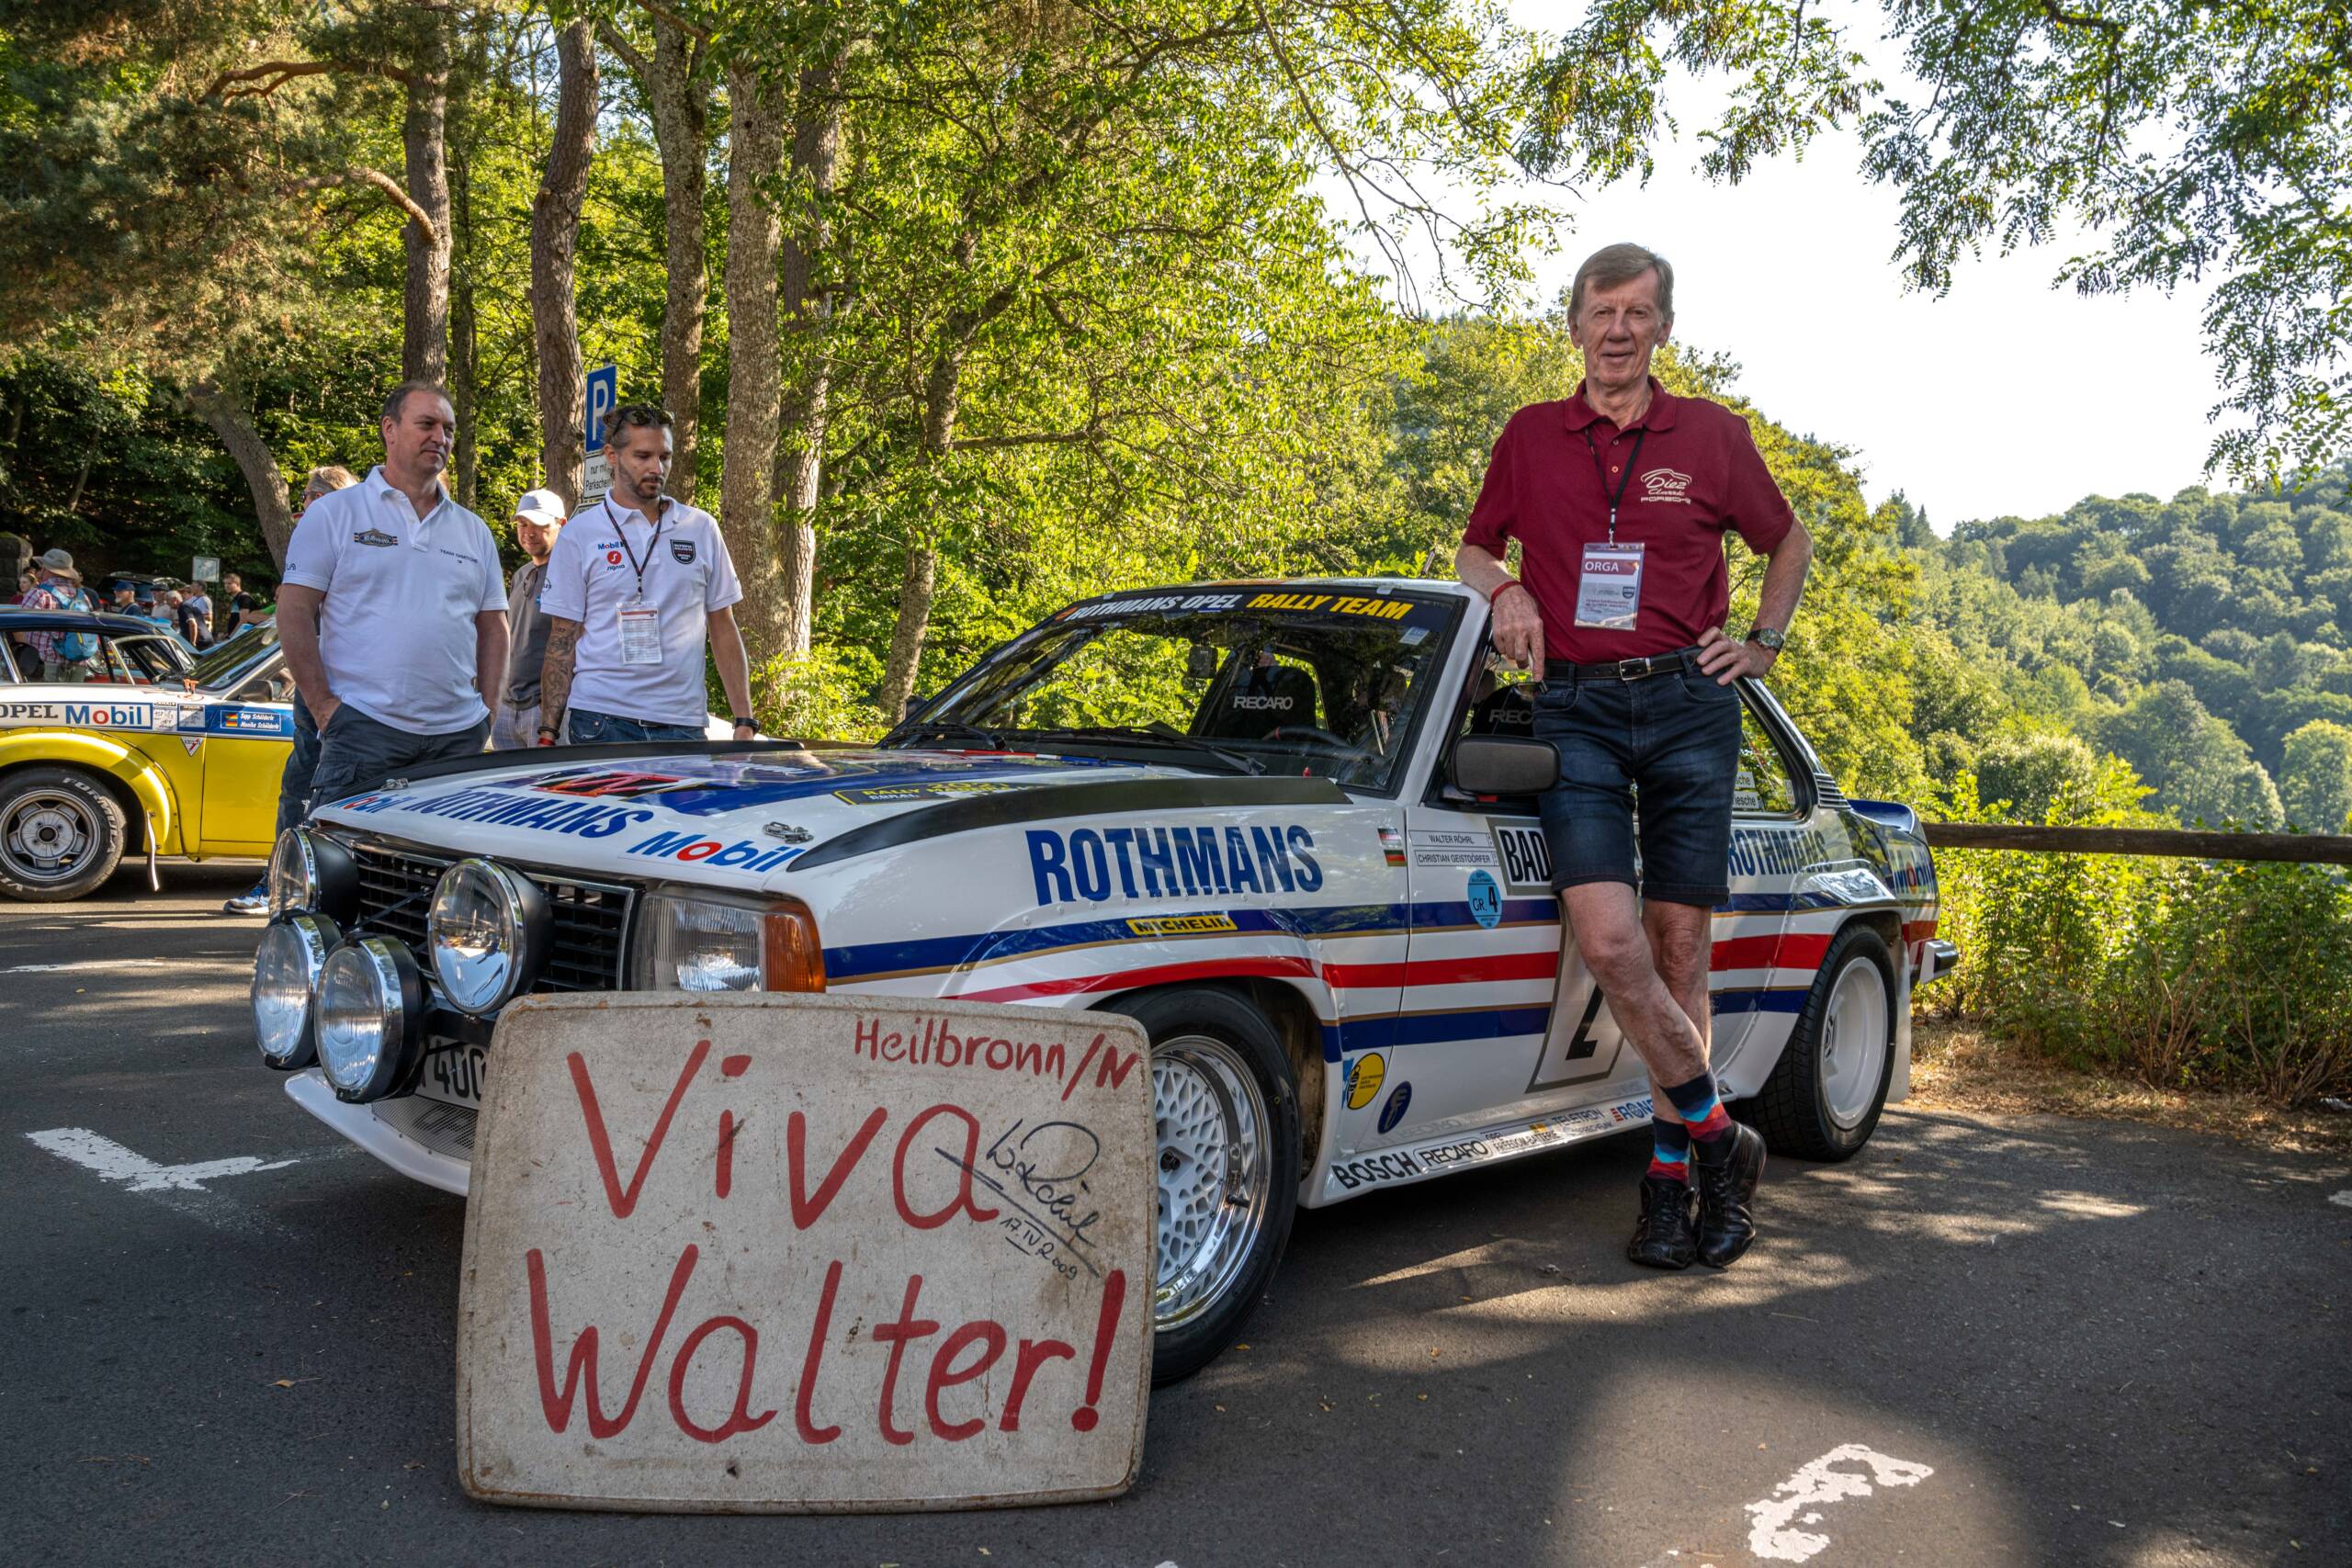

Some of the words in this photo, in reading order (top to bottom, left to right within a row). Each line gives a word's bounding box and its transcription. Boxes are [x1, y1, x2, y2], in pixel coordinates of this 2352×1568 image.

[597, 541, 619, 550] Mobil
[1584, 560, 1619, 572] ORGA
[1063, 595, 1183, 622] ROTHMANS
[1180, 593, 1243, 609] OPEL
[1246, 592, 1334, 612] RALLY
[1329, 595, 1415, 621] TEAM
[1232, 695, 1295, 710] RECARO
[65, 705, 142, 725] Mobil
[1488, 708, 1532, 726] REC
[1428, 833, 1453, 844] WALTER
[1453, 833, 1476, 844] RÖHRL
[626, 830, 807, 873] Mobil
[1418, 854, 1450, 863] CHRISTIAN
[1450, 853, 1490, 863] GEISTDÖRFER
[1498, 830, 1553, 882] BAD
[1024, 824, 1324, 907] ROTHMANS
[1488, 886, 1498, 913] 4
[1135, 918, 1231, 933] MICHELIN
[566, 1039, 1001, 1230] Viva
[1330, 1151, 1422, 1190] BOSCH
[1419, 1140, 1488, 1168] RECARO
[1616, 1099, 1655, 1121] RON
[526, 1244, 1126, 1446] Walter!
